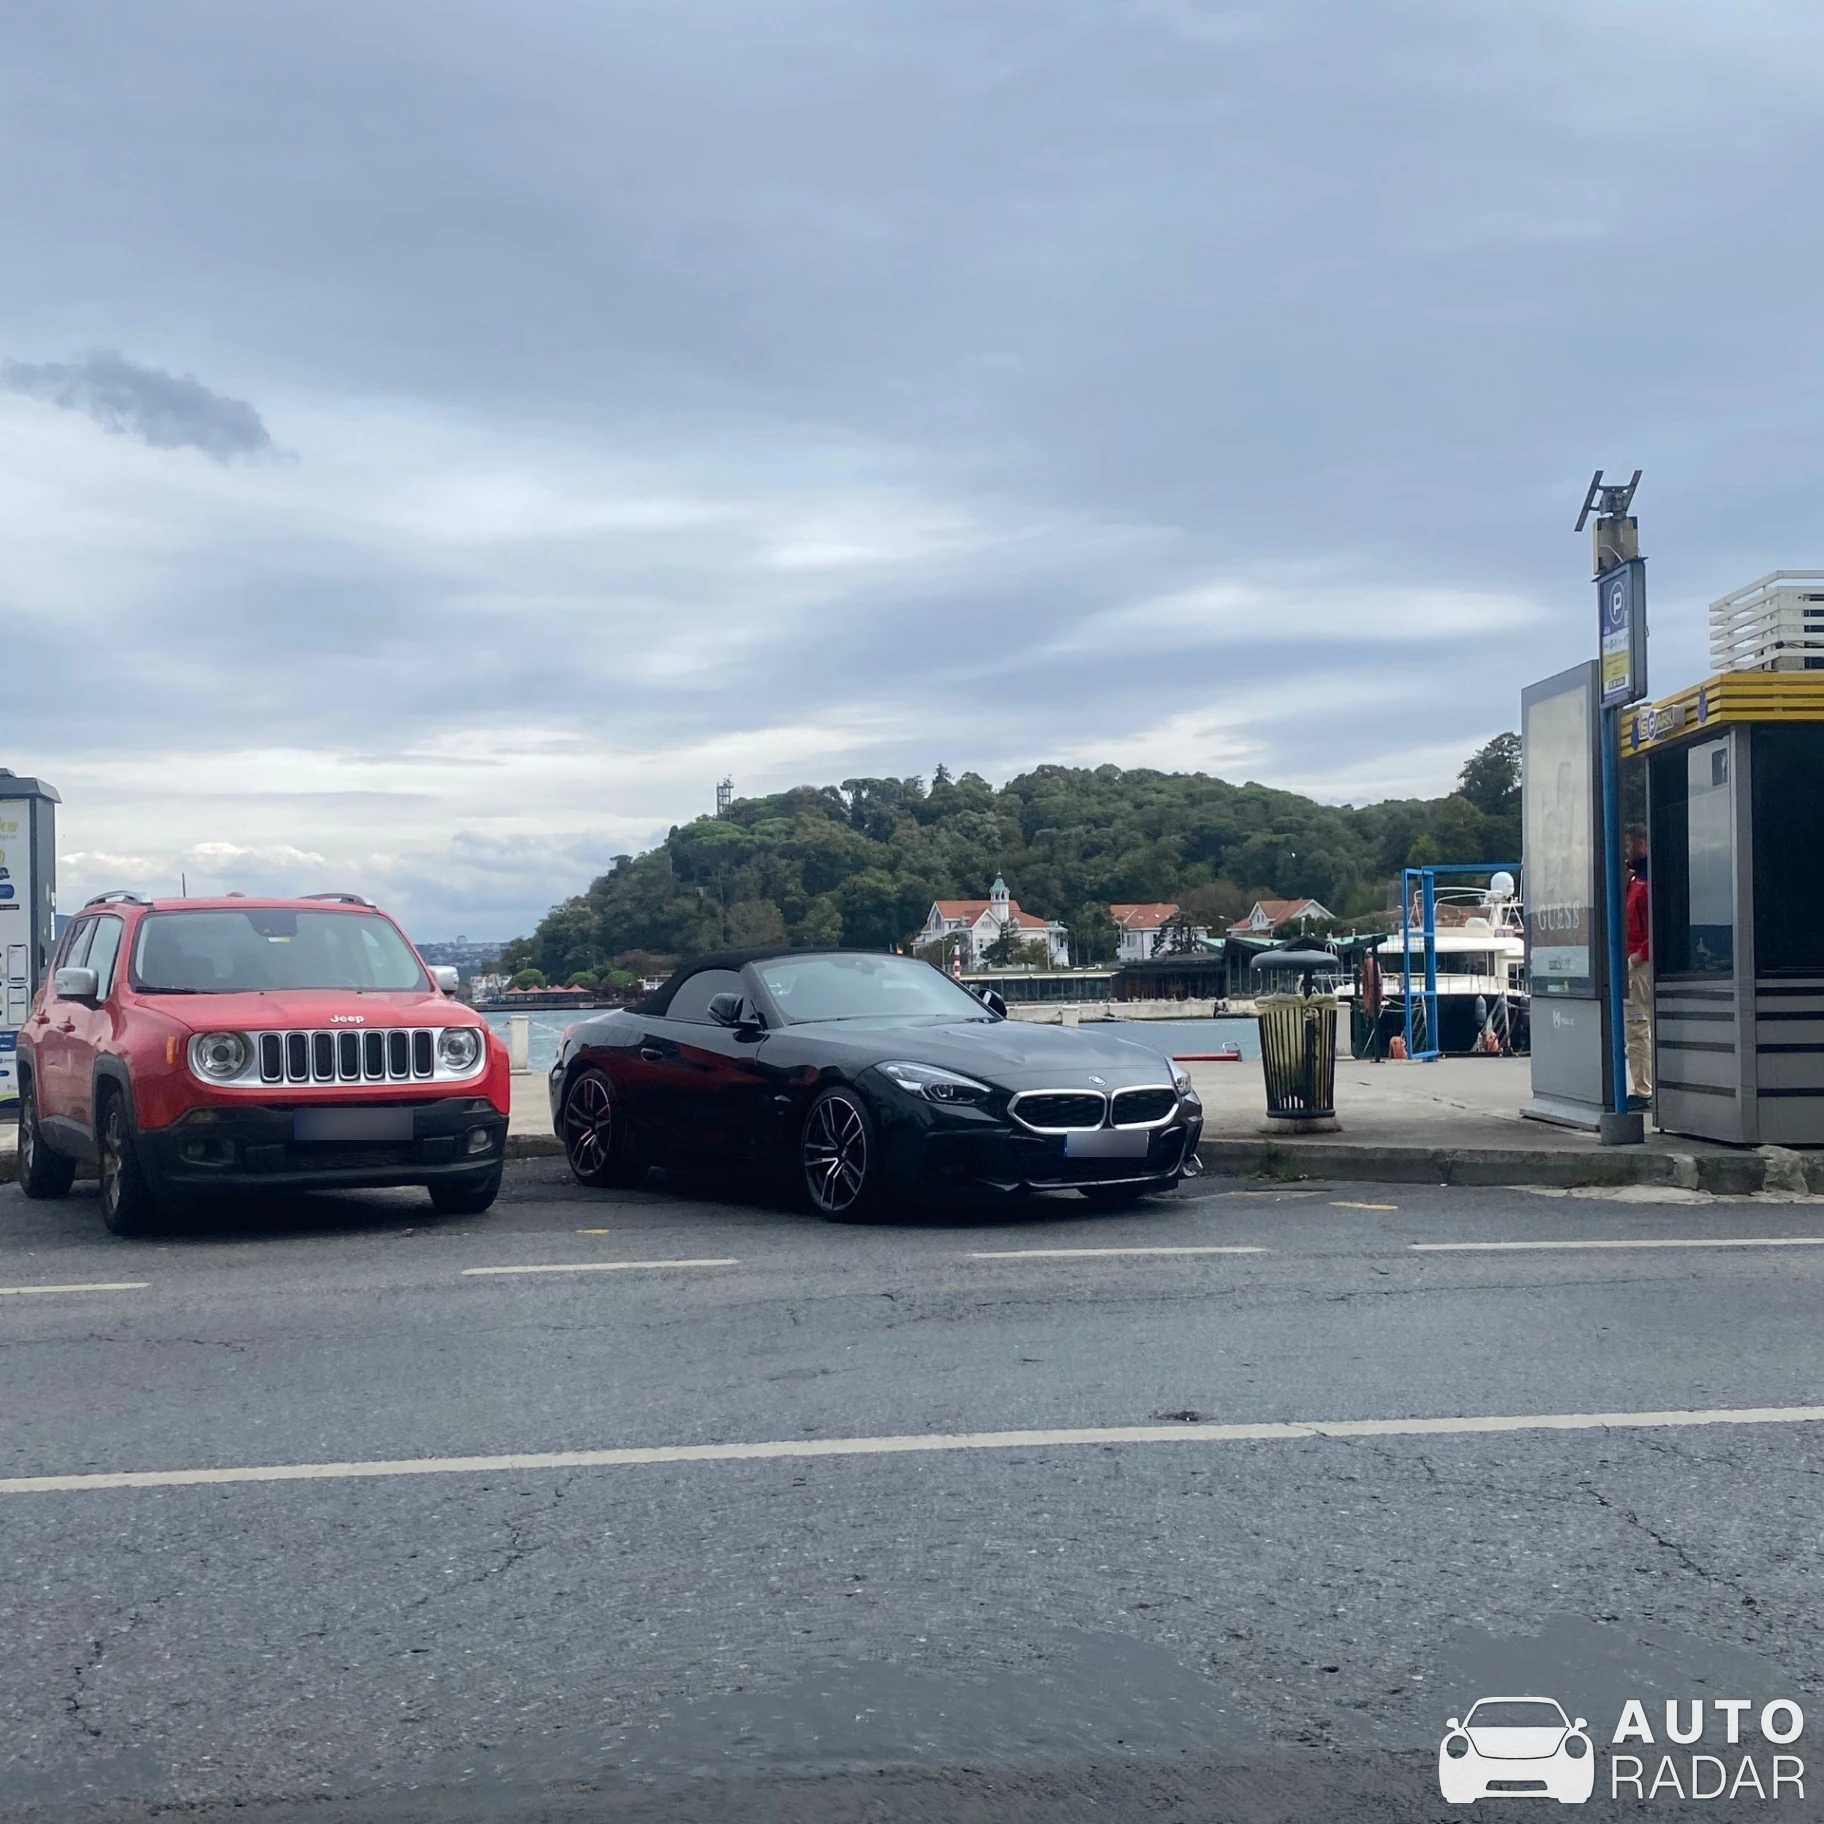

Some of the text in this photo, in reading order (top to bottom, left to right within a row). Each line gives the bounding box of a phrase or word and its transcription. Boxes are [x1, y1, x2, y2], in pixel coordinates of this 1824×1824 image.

[1613, 592, 1622, 616] P
[1537, 901, 1580, 931] GUESS
[330, 1015, 364, 1024] Jeep
